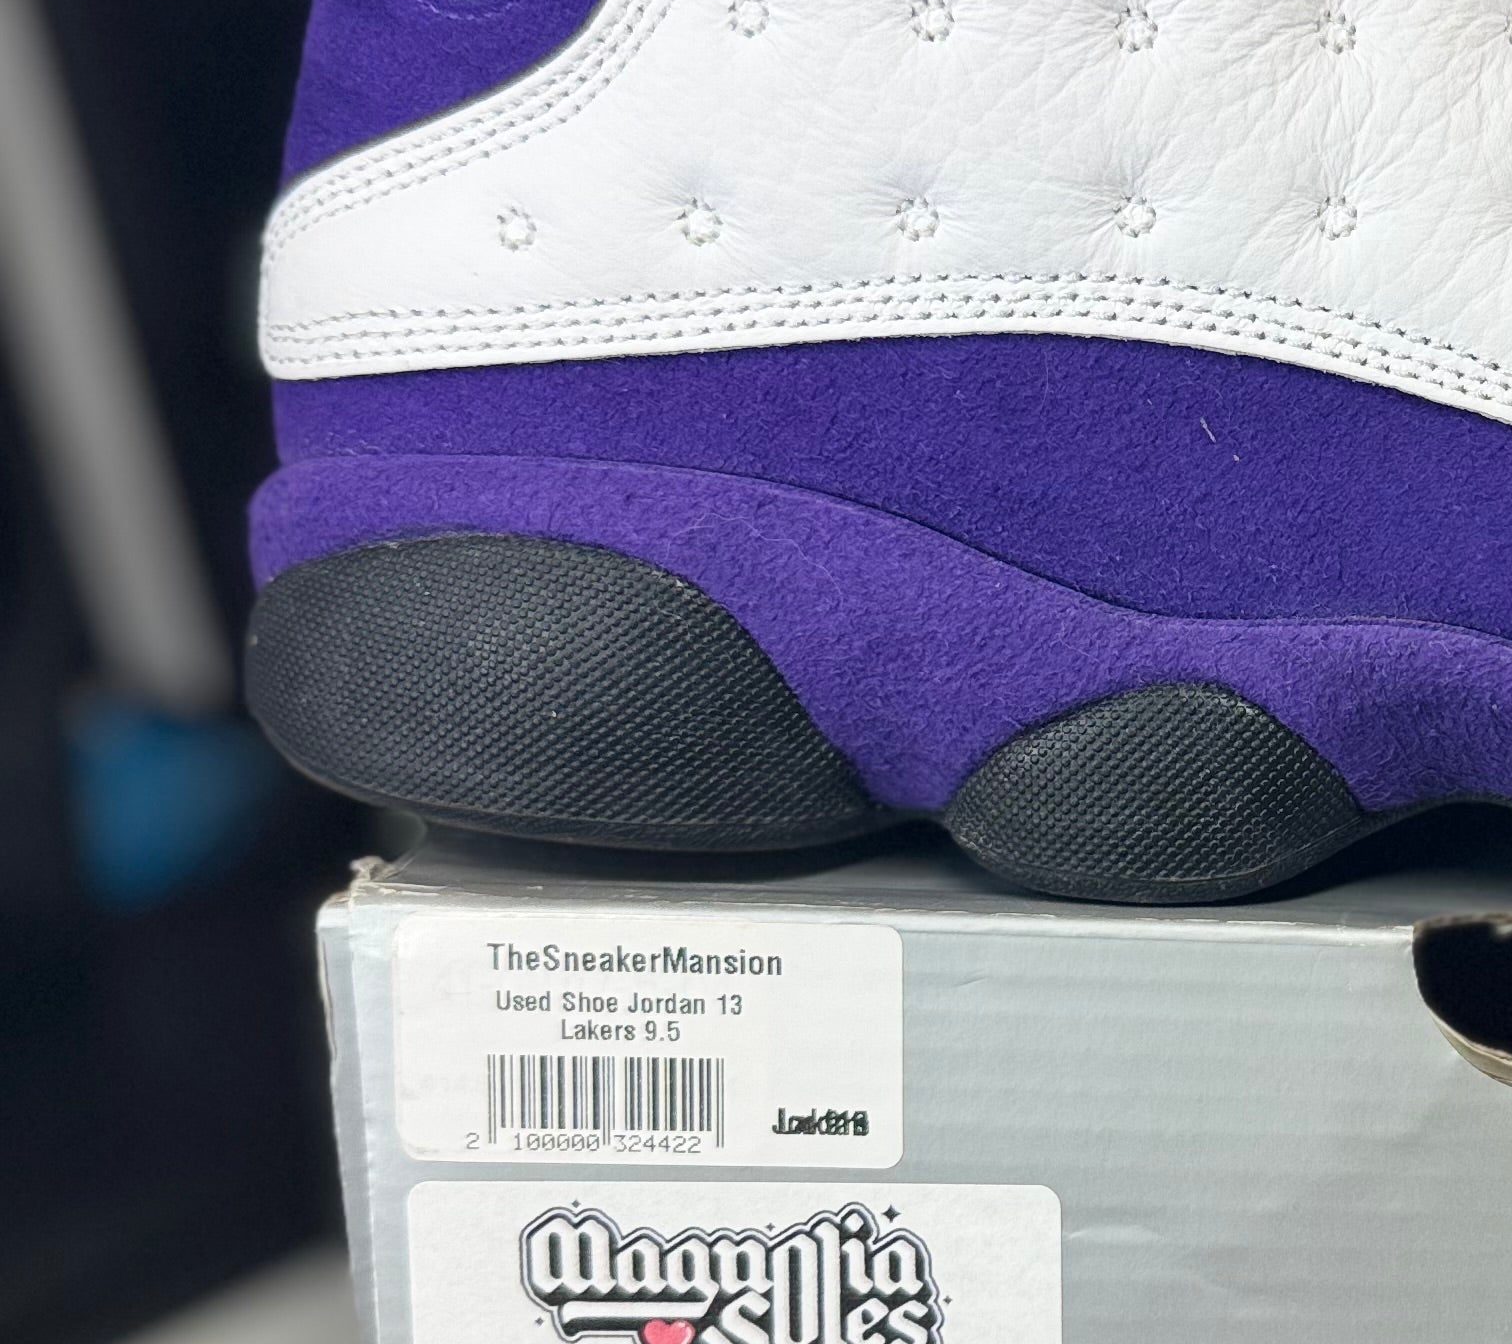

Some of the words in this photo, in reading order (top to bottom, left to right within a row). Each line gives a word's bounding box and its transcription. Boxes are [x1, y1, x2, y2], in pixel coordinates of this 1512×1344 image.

[486, 942, 783, 976] TheSneakerMansion
[495, 989, 552, 1012] Used
[562, 991, 618, 1014] Shoe
[627, 992, 706, 1016] Jordan
[716, 994, 743, 1016] 13
[560, 1018, 636, 1042] Lakers
[644, 1020, 681, 1042] 9.5
[465, 1132, 481, 1150] 2
[513, 1132, 600, 1152] 100000
[613, 1134, 702, 1154] 324422
